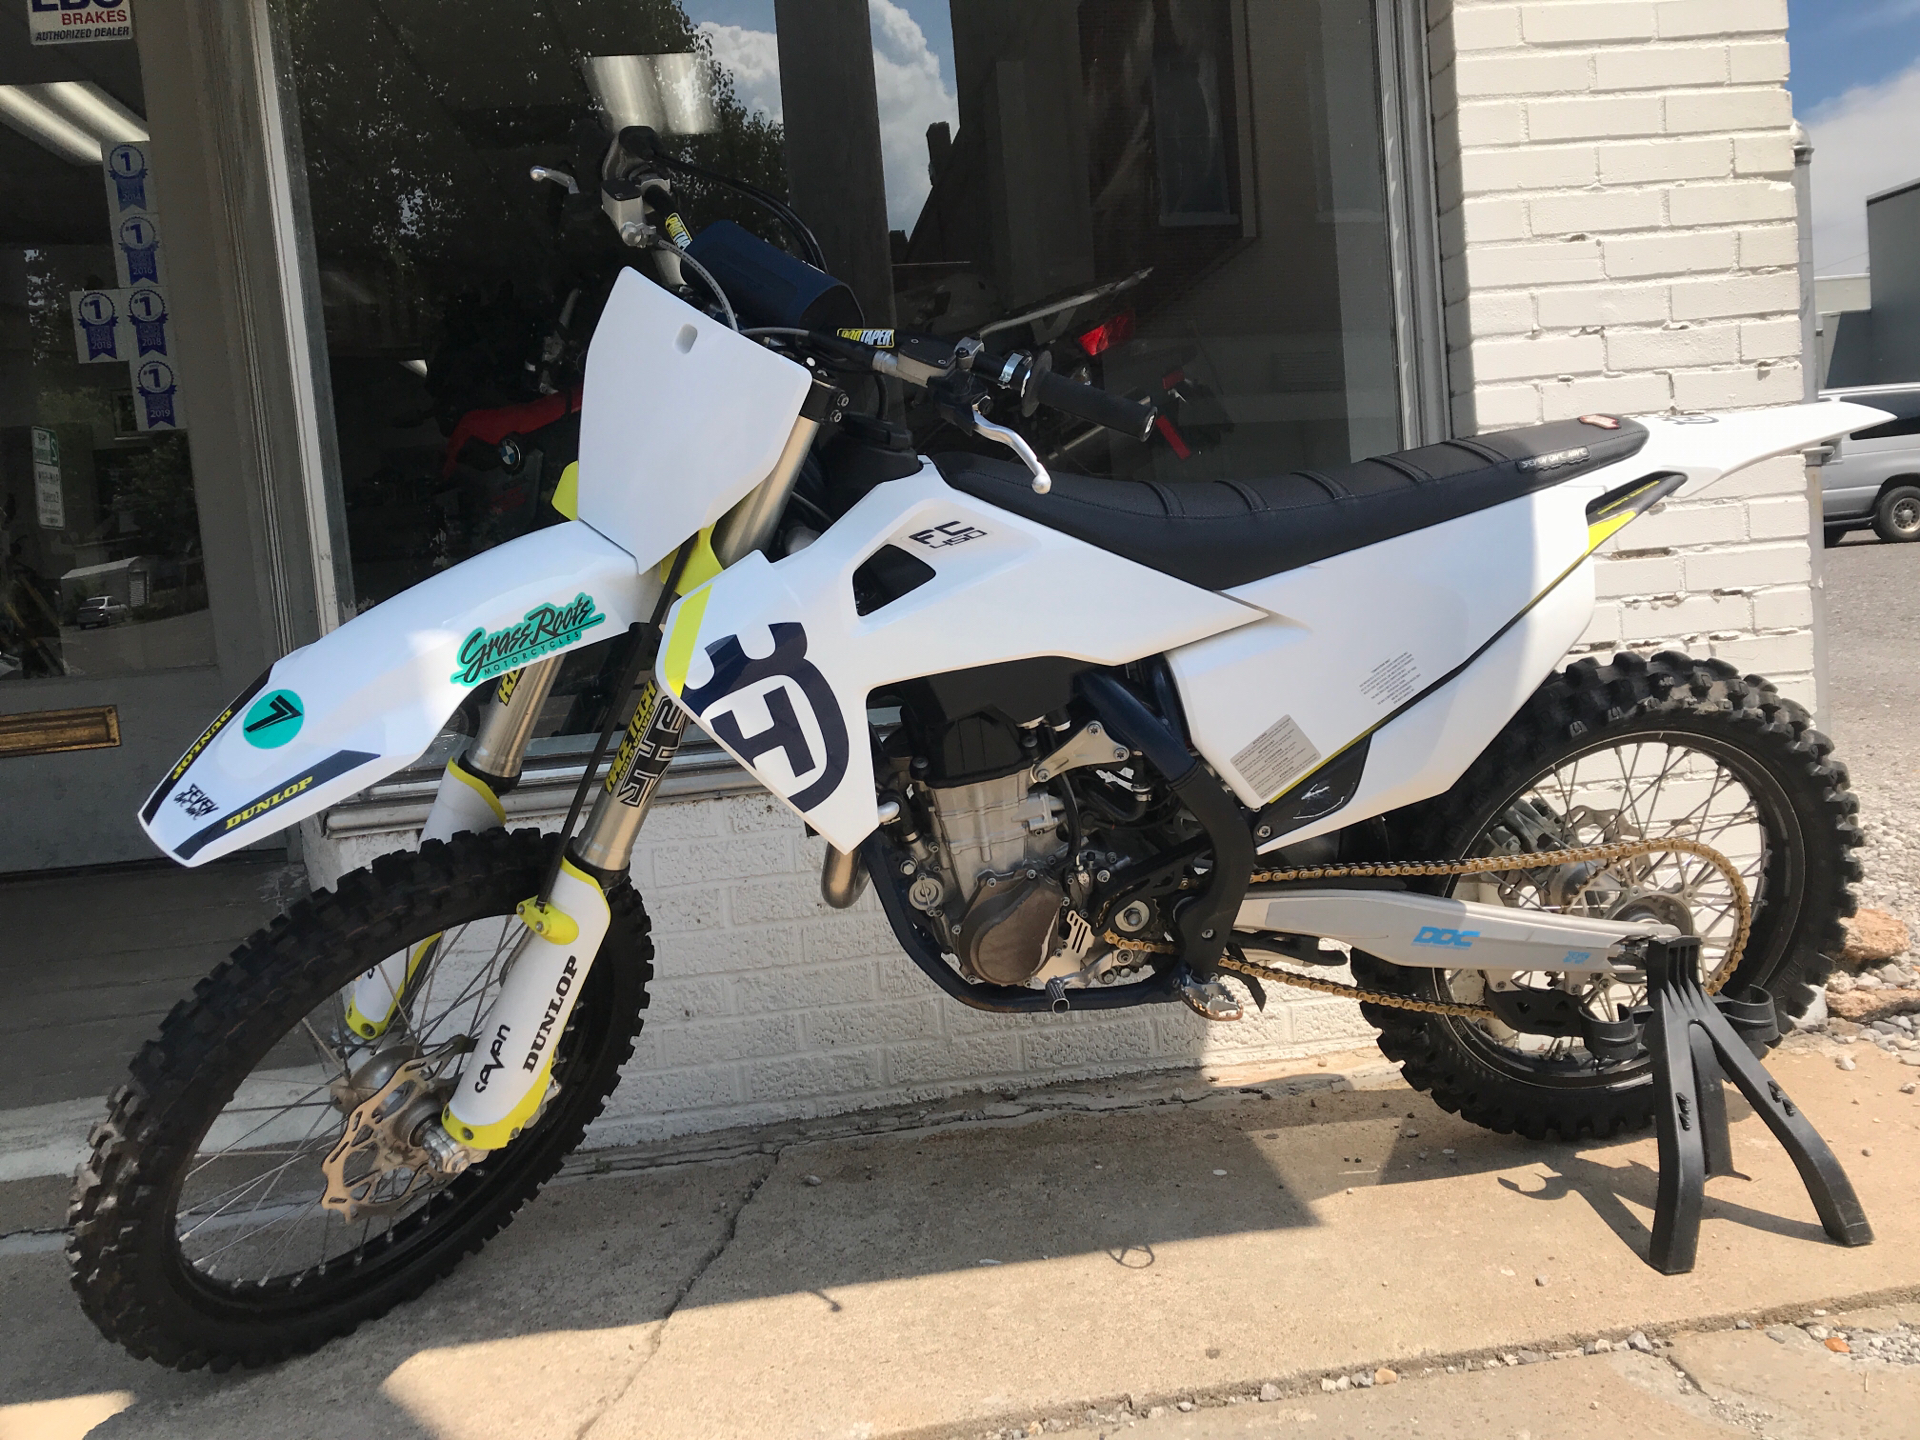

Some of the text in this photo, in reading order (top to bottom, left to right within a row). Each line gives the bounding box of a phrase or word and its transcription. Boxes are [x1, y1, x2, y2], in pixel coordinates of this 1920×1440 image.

[61, 10, 127, 25] BRAKES
[35, 26, 130, 41] AUTHORIZED DEALER
[91, 340, 112, 350] 2018
[141, 336, 162, 346] 2018
[149, 408, 171, 418] 2019
[908, 520, 976, 545] FC
[929, 529, 988, 549] 450
[484, 631, 580, 676] MOTORCYCLES
[172, 708, 232, 780] DUNLOP
[603, 678, 657, 793] RACE TECH
[182, 782, 219, 815] SEVEN
[225, 776, 314, 831] DUNLOP
[522, 955, 578, 1073] DUNLOP
